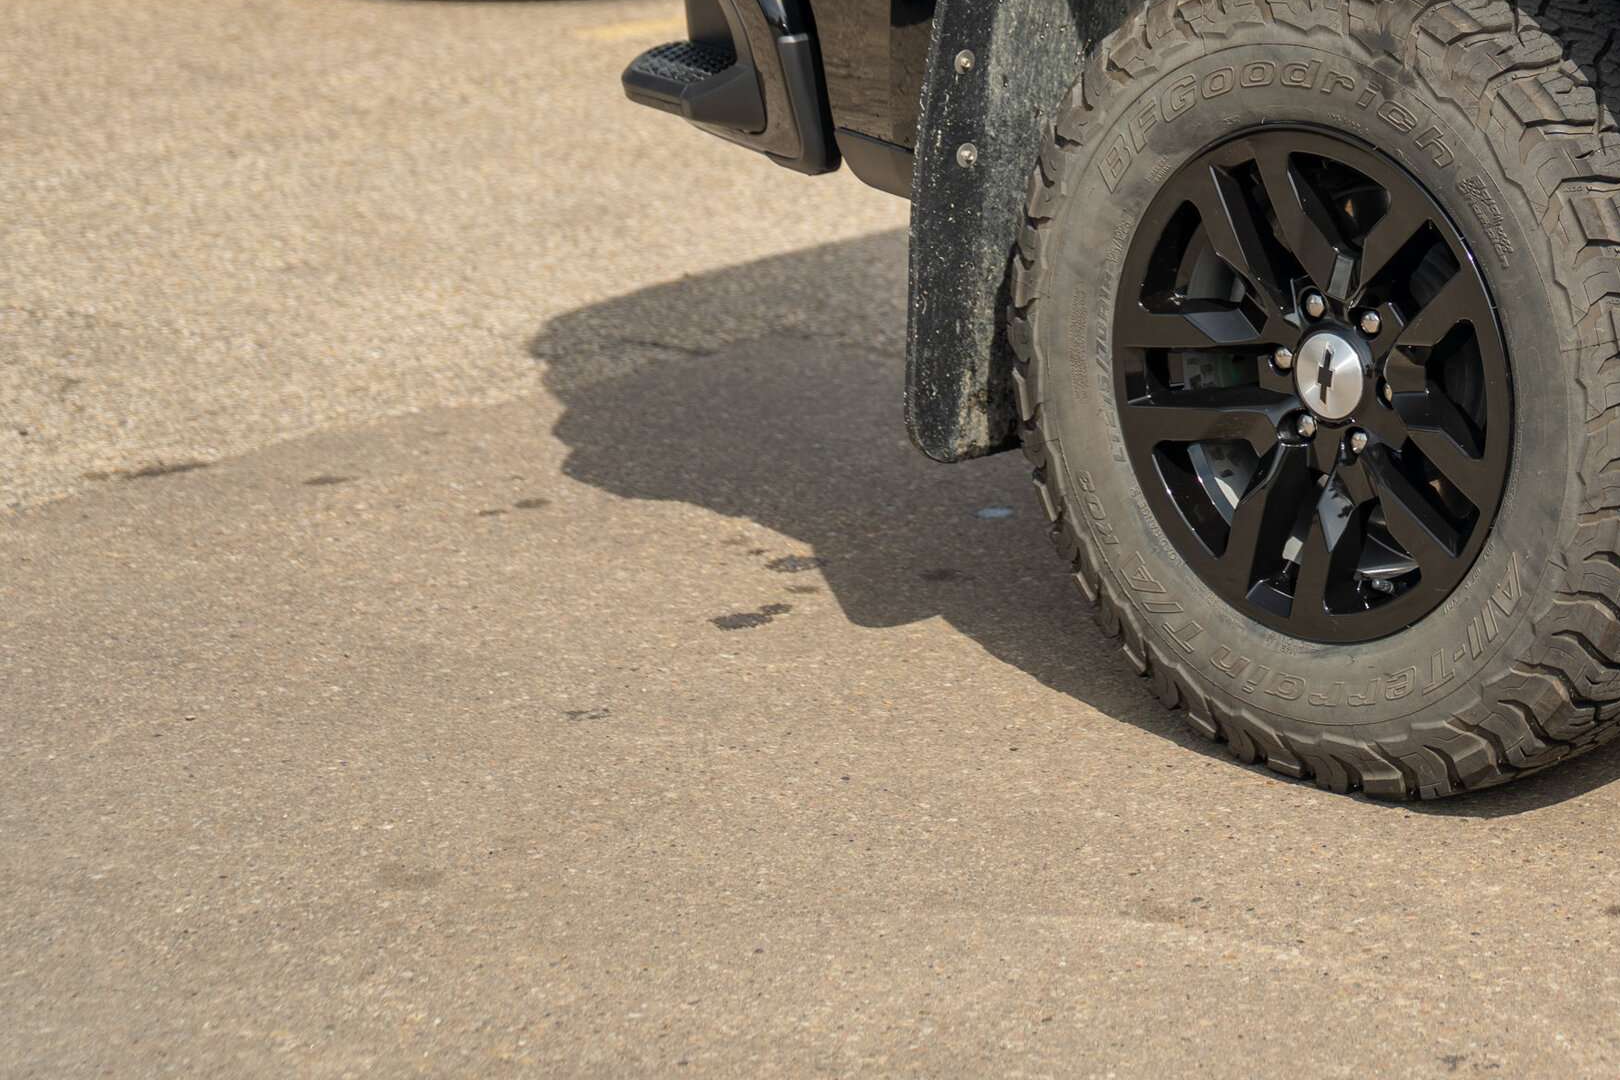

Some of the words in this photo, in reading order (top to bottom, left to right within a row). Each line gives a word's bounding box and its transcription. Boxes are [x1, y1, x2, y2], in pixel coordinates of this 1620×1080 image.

[1098, 59, 1455, 194] BFGoodrich
[1120, 551, 1203, 654] T/A
[1209, 552, 1522, 707] All-Terrain
